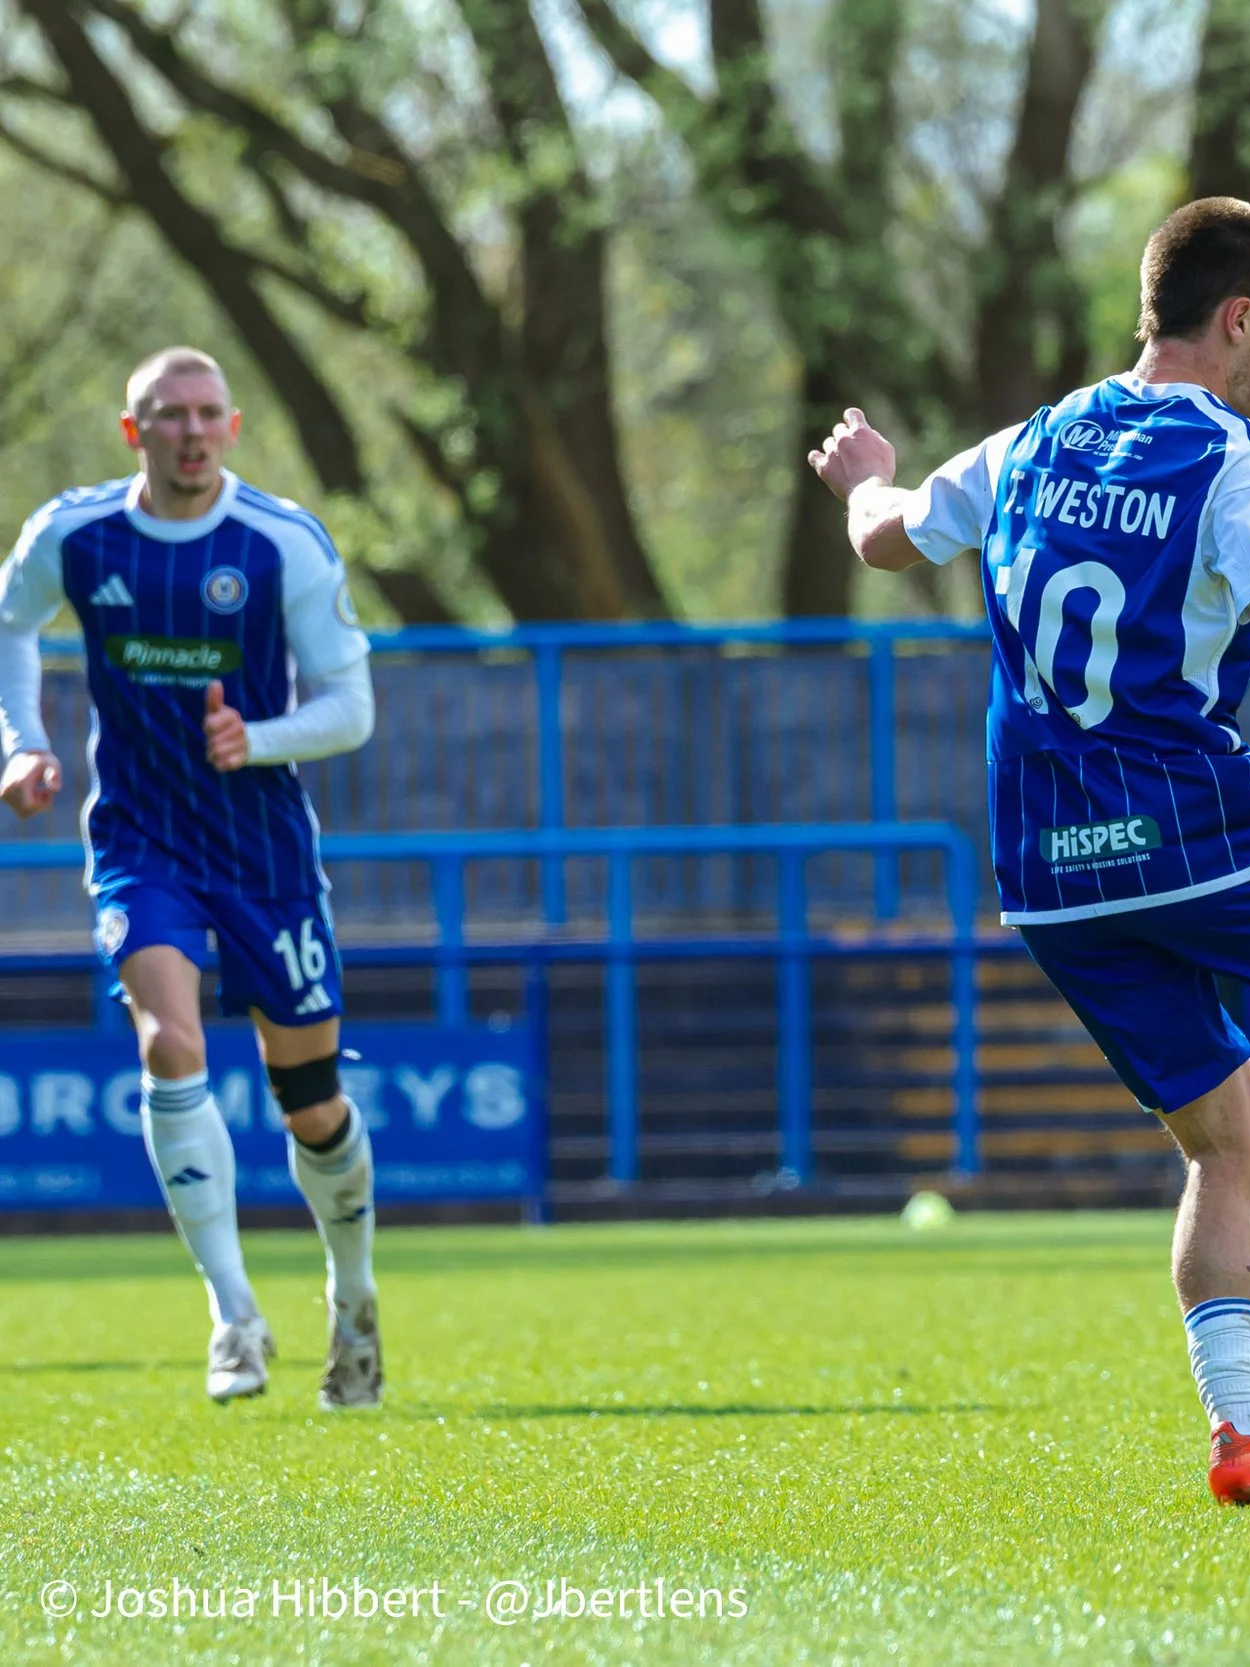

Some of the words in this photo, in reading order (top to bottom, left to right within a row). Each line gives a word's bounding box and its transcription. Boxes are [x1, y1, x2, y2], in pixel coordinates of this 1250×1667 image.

[1003, 469, 1025, 515] T.
[1034, 472, 1176, 540] WESTON
[123, 641, 222, 669] Pinnacle
[995, 547, 1125, 730] 10
[1051, 819, 1146, 862] HiSPEC
[273, 917, 327, 991] 16
